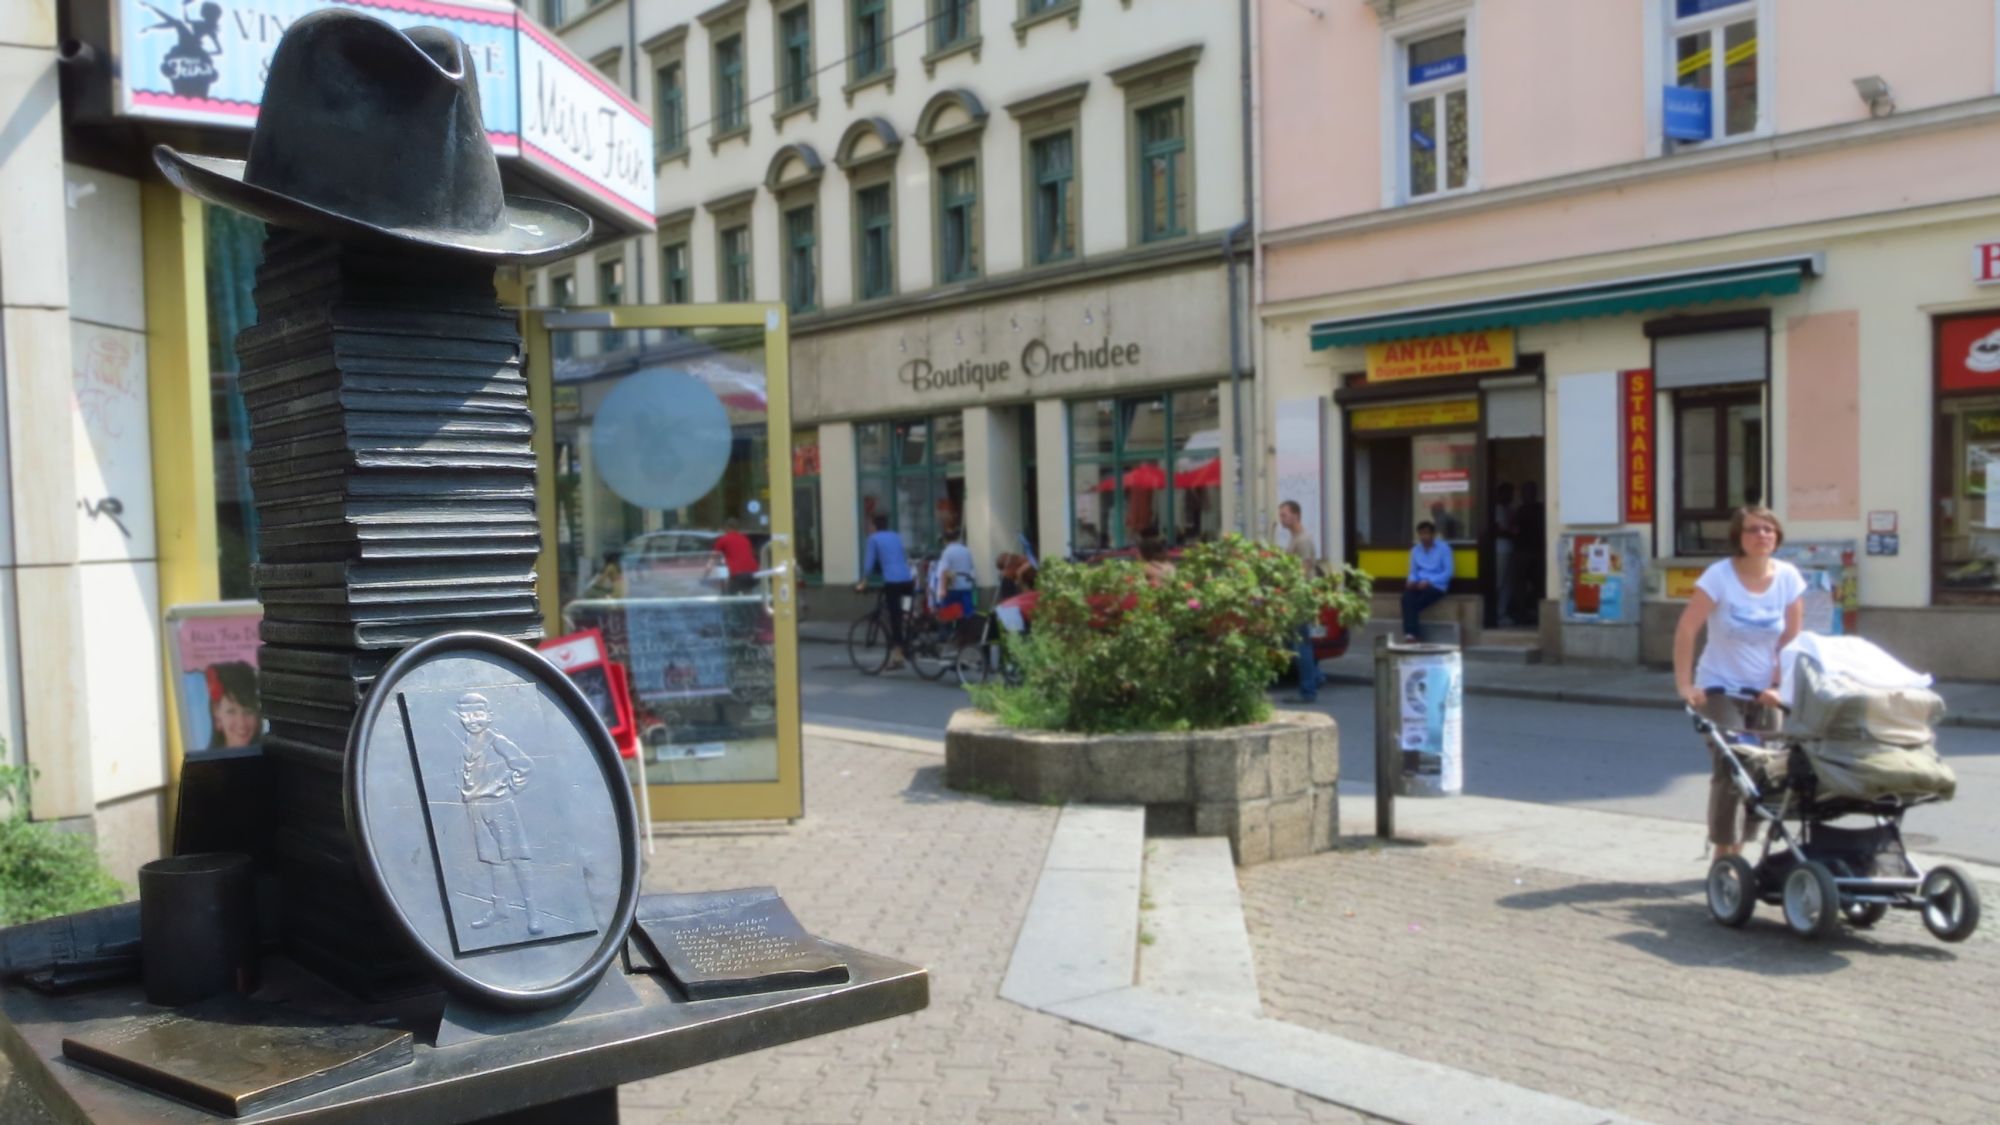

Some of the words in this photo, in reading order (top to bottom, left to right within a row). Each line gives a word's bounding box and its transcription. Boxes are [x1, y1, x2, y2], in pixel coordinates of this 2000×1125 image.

[528, 60, 596, 161] Miss
[597, 107, 648, 191] Fein
[898, 358, 1010, 393] Boutique
[1019, 337, 1141, 379] Orchidee
[1384, 334, 1491, 363] ANTALYA
